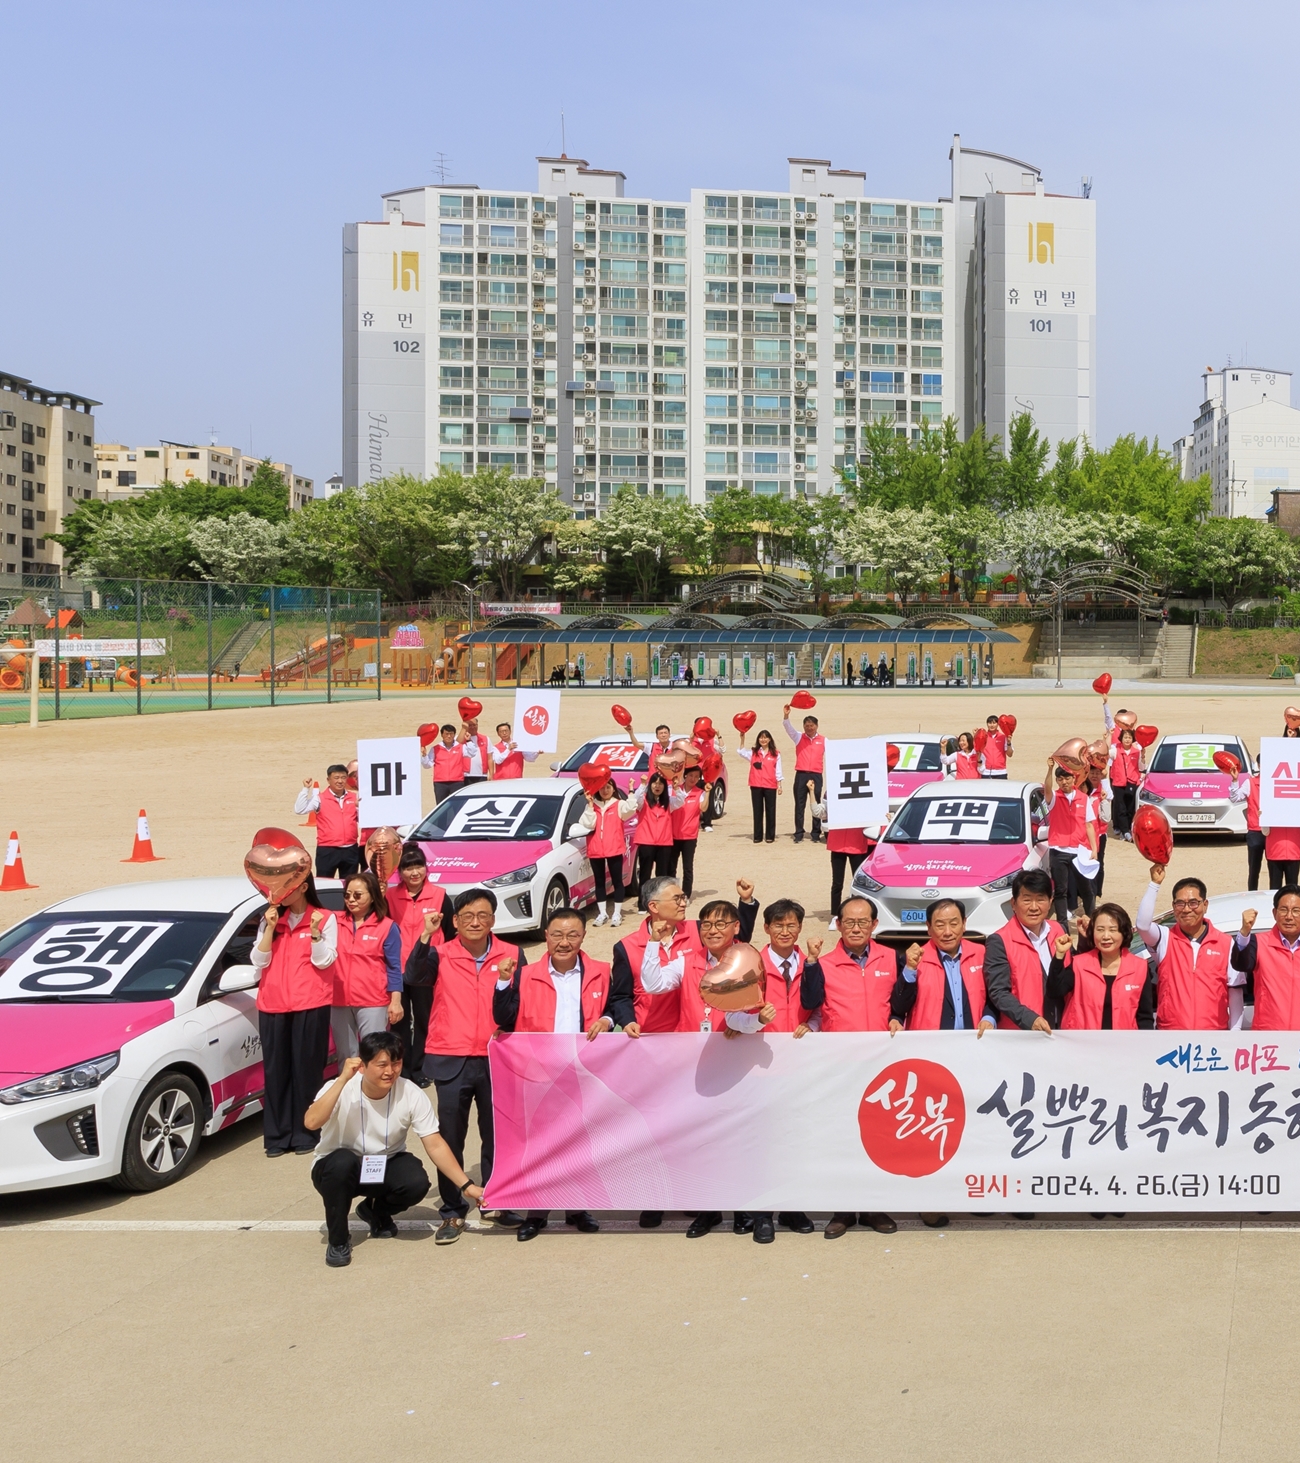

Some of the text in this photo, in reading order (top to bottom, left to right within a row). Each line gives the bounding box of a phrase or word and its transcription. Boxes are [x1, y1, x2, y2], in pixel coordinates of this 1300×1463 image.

[1007, 288, 1076, 307] 휴먼빌
[1029, 319, 1052, 333] 101
[393, 341, 420, 353] 102
[1250, 373, 1276, 386] 두영
[1179, 745, 1219, 769] 함
[371, 762, 406, 796] 마
[838, 763, 873, 799] 포
[465, 800, 528, 833] 실
[927, 802, 989, 836] 뿌
[19, 925, 159, 992] 행
[1156, 1043, 1228, 1073] 새로운
[1235, 1044, 1290, 1074] 마포
[865, 1071, 955, 1161] 실복
[965, 1175, 1007, 1197] 일시
[1031, 1175, 1099, 1196] 2024.
[1107, 1175, 1127, 1196] 4.
[1137, 1174, 1209, 1198] 26.(금)
[1218, 1175, 1280, 1196] 14:00
